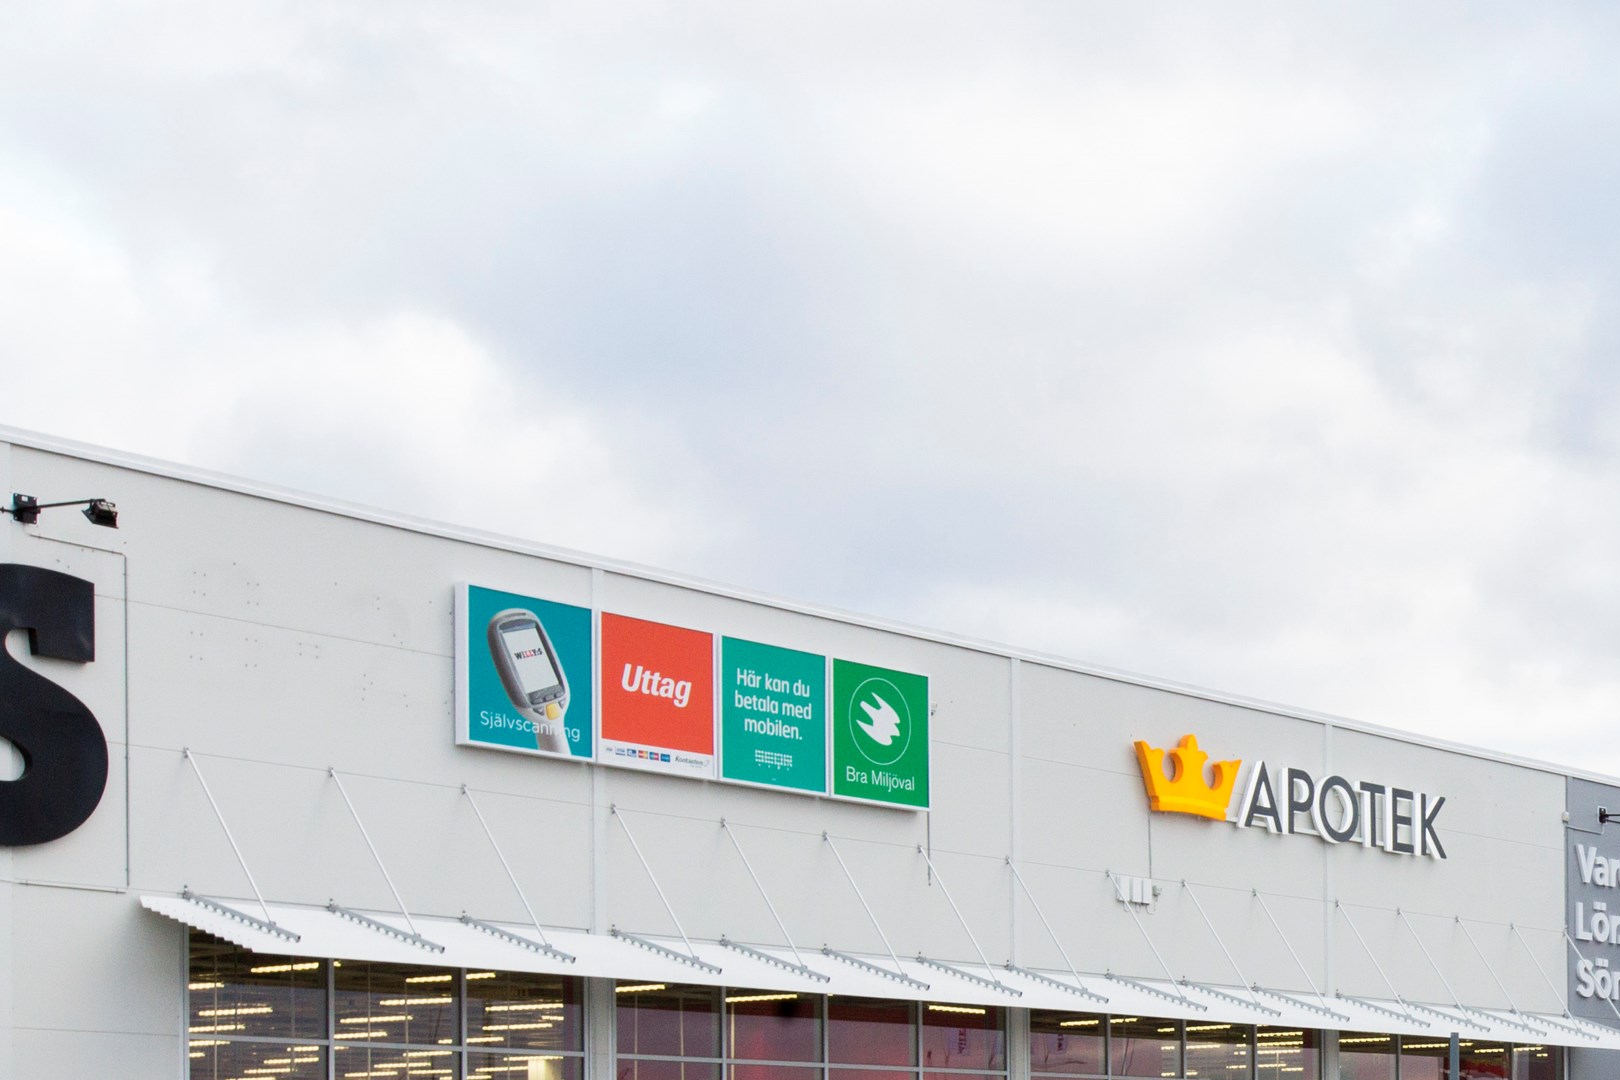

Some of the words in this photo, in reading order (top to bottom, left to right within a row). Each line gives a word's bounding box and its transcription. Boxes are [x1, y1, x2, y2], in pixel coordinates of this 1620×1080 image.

[621, 663, 692, 708] Uttag
[736, 667, 762, 688] Här
[764, 673, 790, 694] kan
[792, 679, 810, 698] du
[0, 563, 108, 846] S
[734, 689, 779, 714] betala
[781, 703, 812, 720] med
[480, 710, 581, 742] Självscannng
[744, 717, 803, 740] mobilen.
[846, 765, 868, 784] Bra
[871, 769, 915, 792] Miljöval
[1237, 760, 1447, 860] APOTEK
